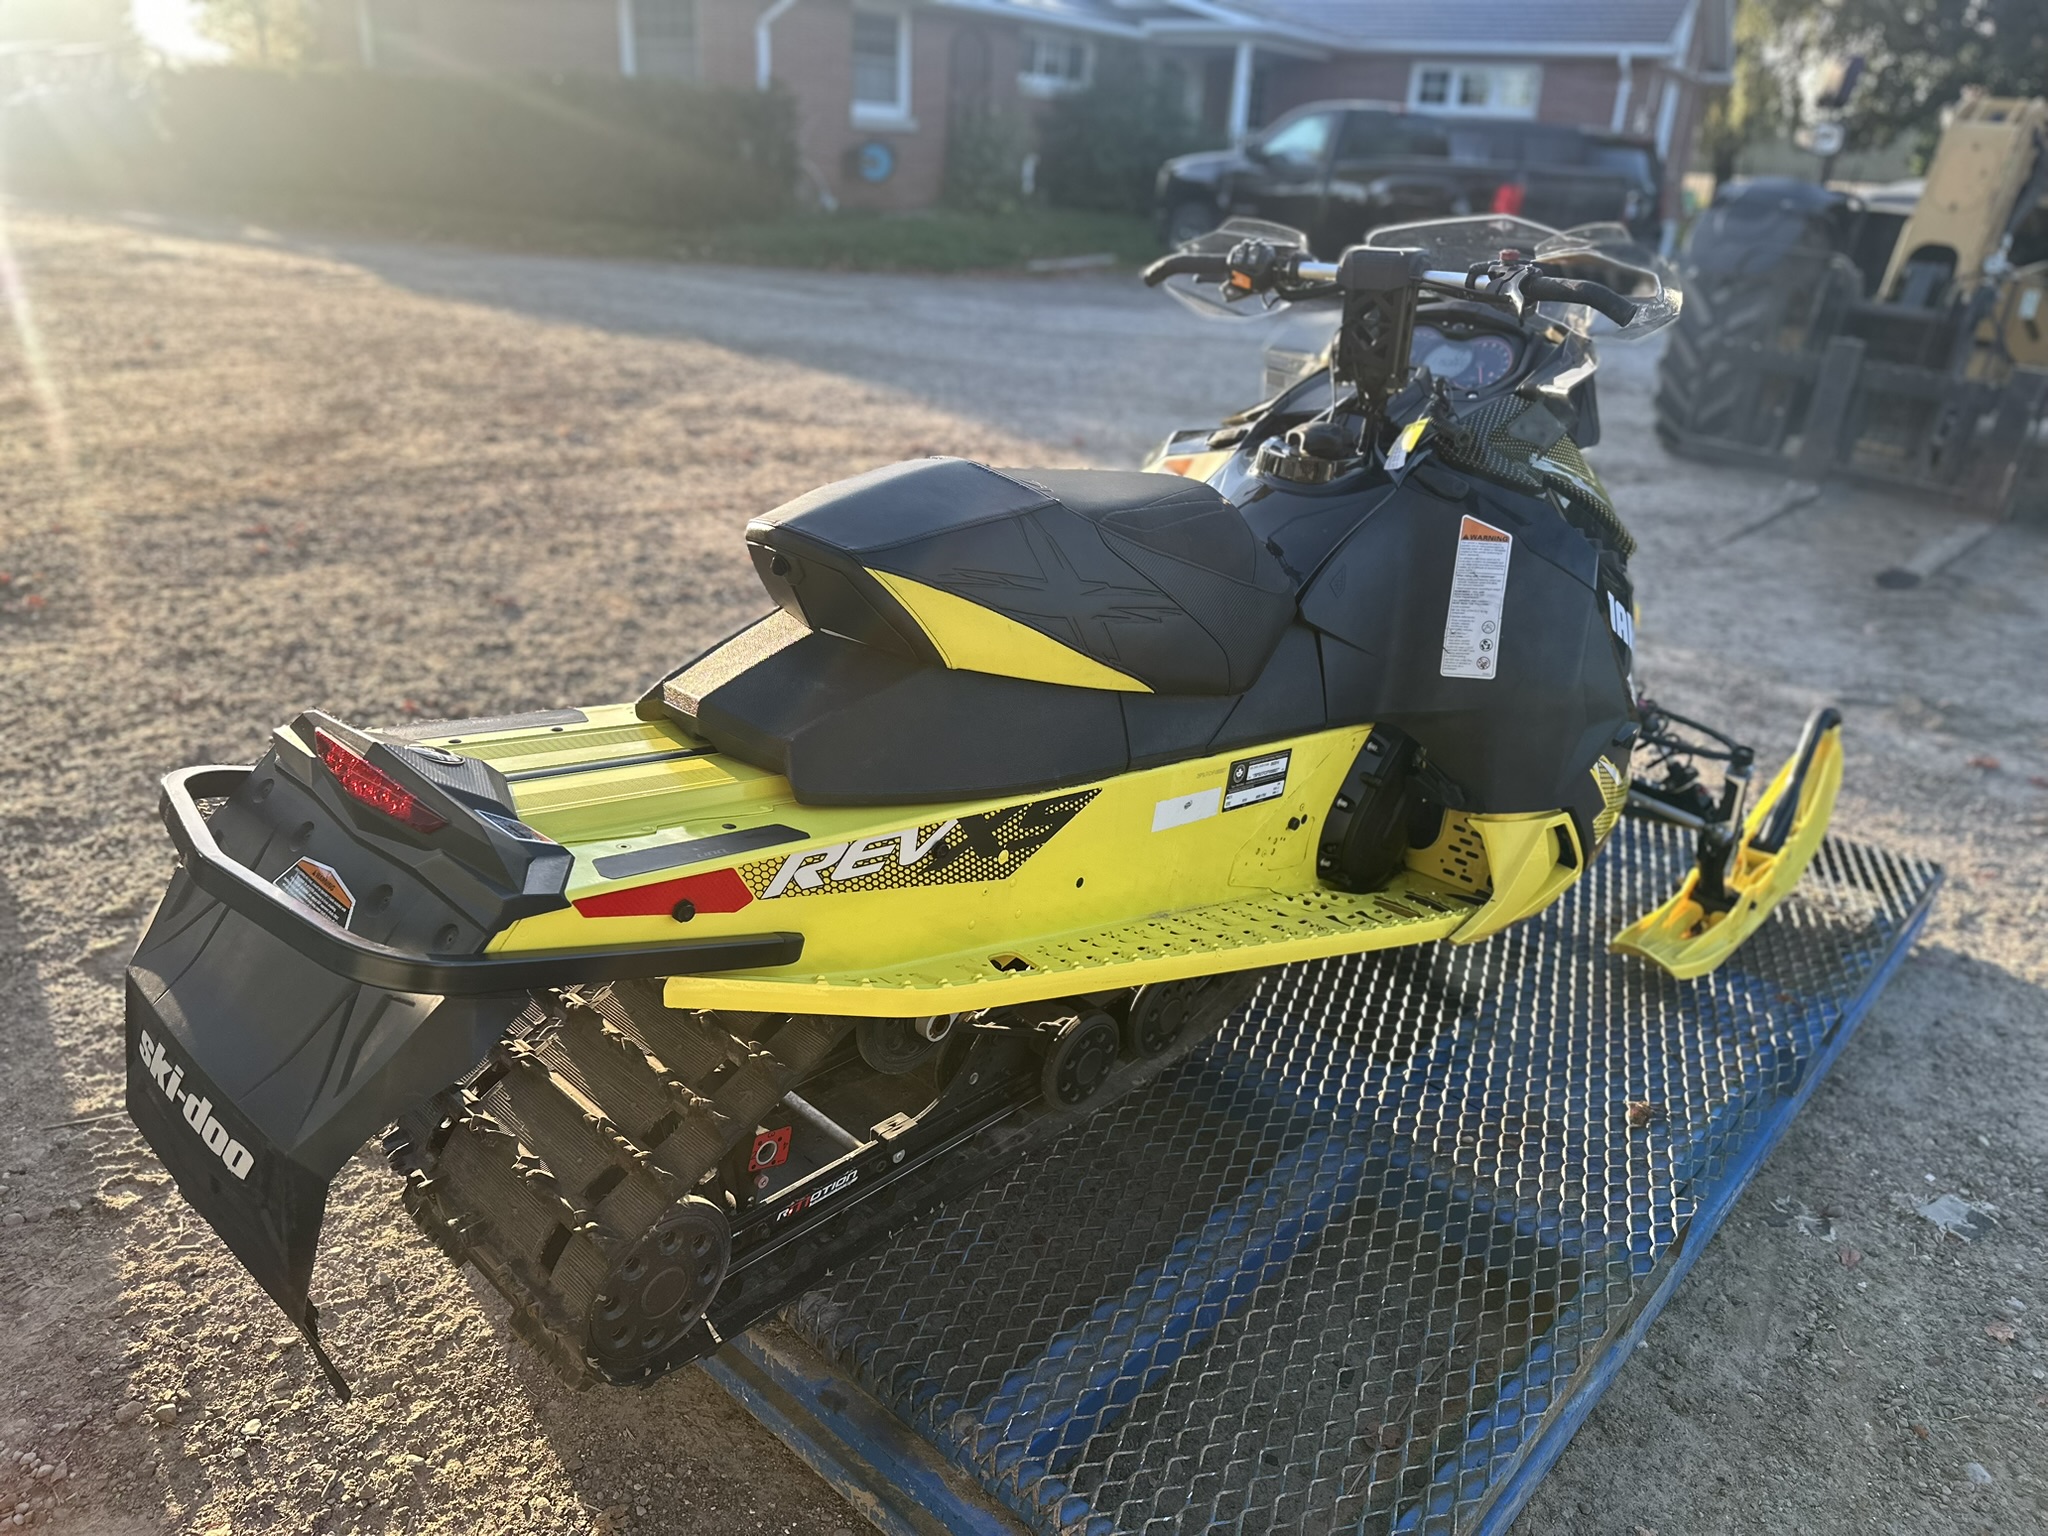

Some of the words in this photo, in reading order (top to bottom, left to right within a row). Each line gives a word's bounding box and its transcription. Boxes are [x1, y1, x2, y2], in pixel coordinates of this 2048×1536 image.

[1470, 534, 1508, 543] WARNING
[761, 818, 958, 900] REV
[139, 1029, 255, 1181] ski-doo
